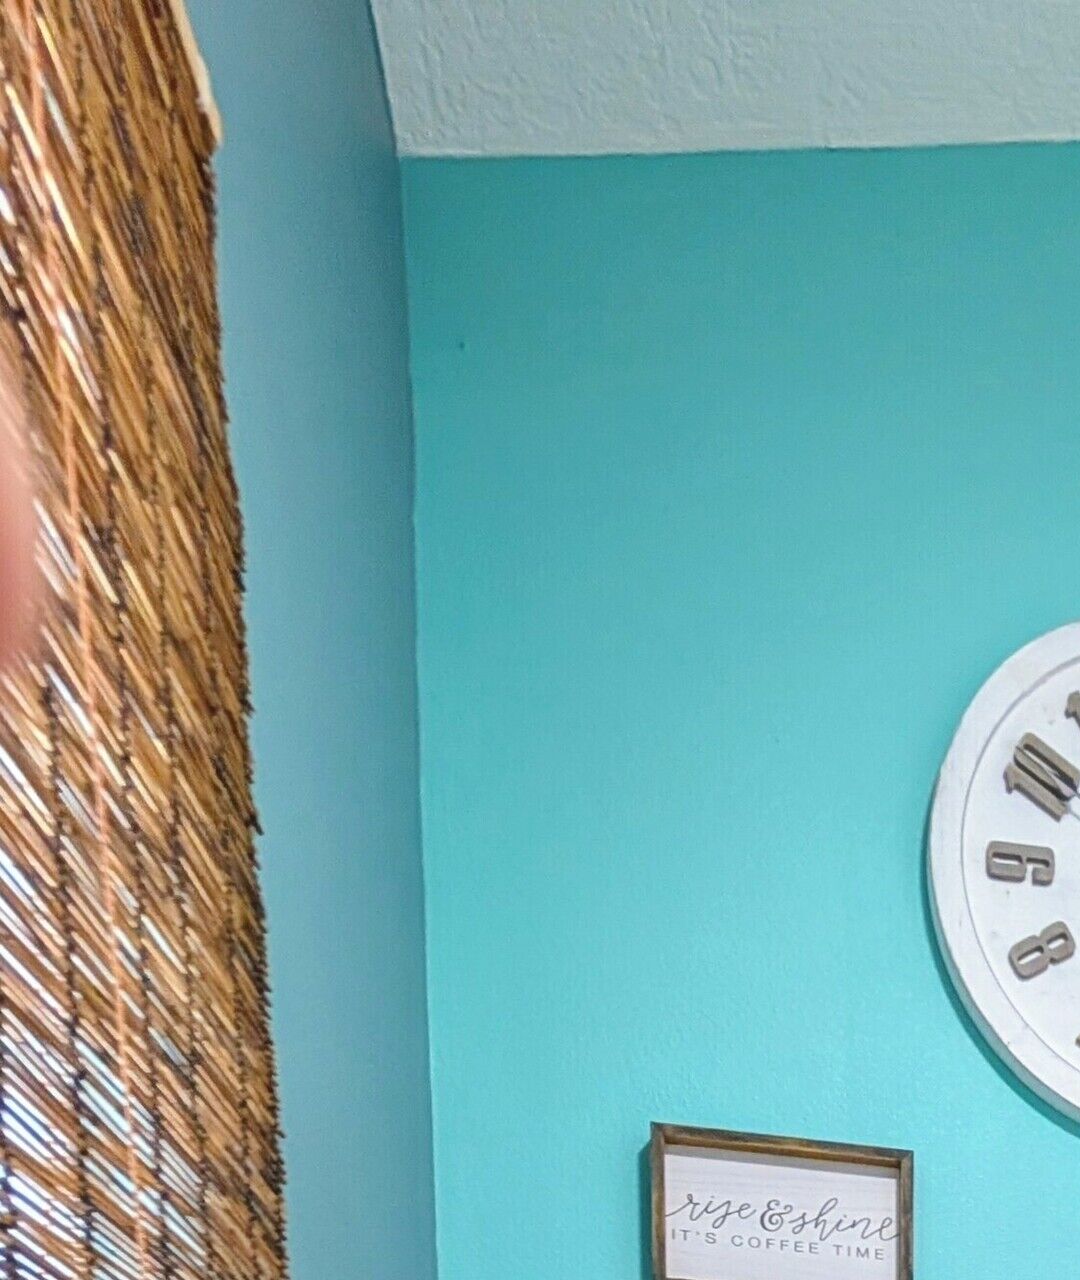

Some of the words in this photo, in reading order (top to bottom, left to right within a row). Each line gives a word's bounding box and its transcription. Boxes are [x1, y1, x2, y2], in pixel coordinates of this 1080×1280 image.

[986, 839, 1056, 886] 9
[1008, 921, 1077, 980] 8
[665, 1193, 757, 1229] rise
[789, 1198, 900, 1241] shine
[671, 1229, 717, 1245] IT'S
[731, 1234, 819, 1255] COFFEE
[833, 1244, 885, 1261] TIME
